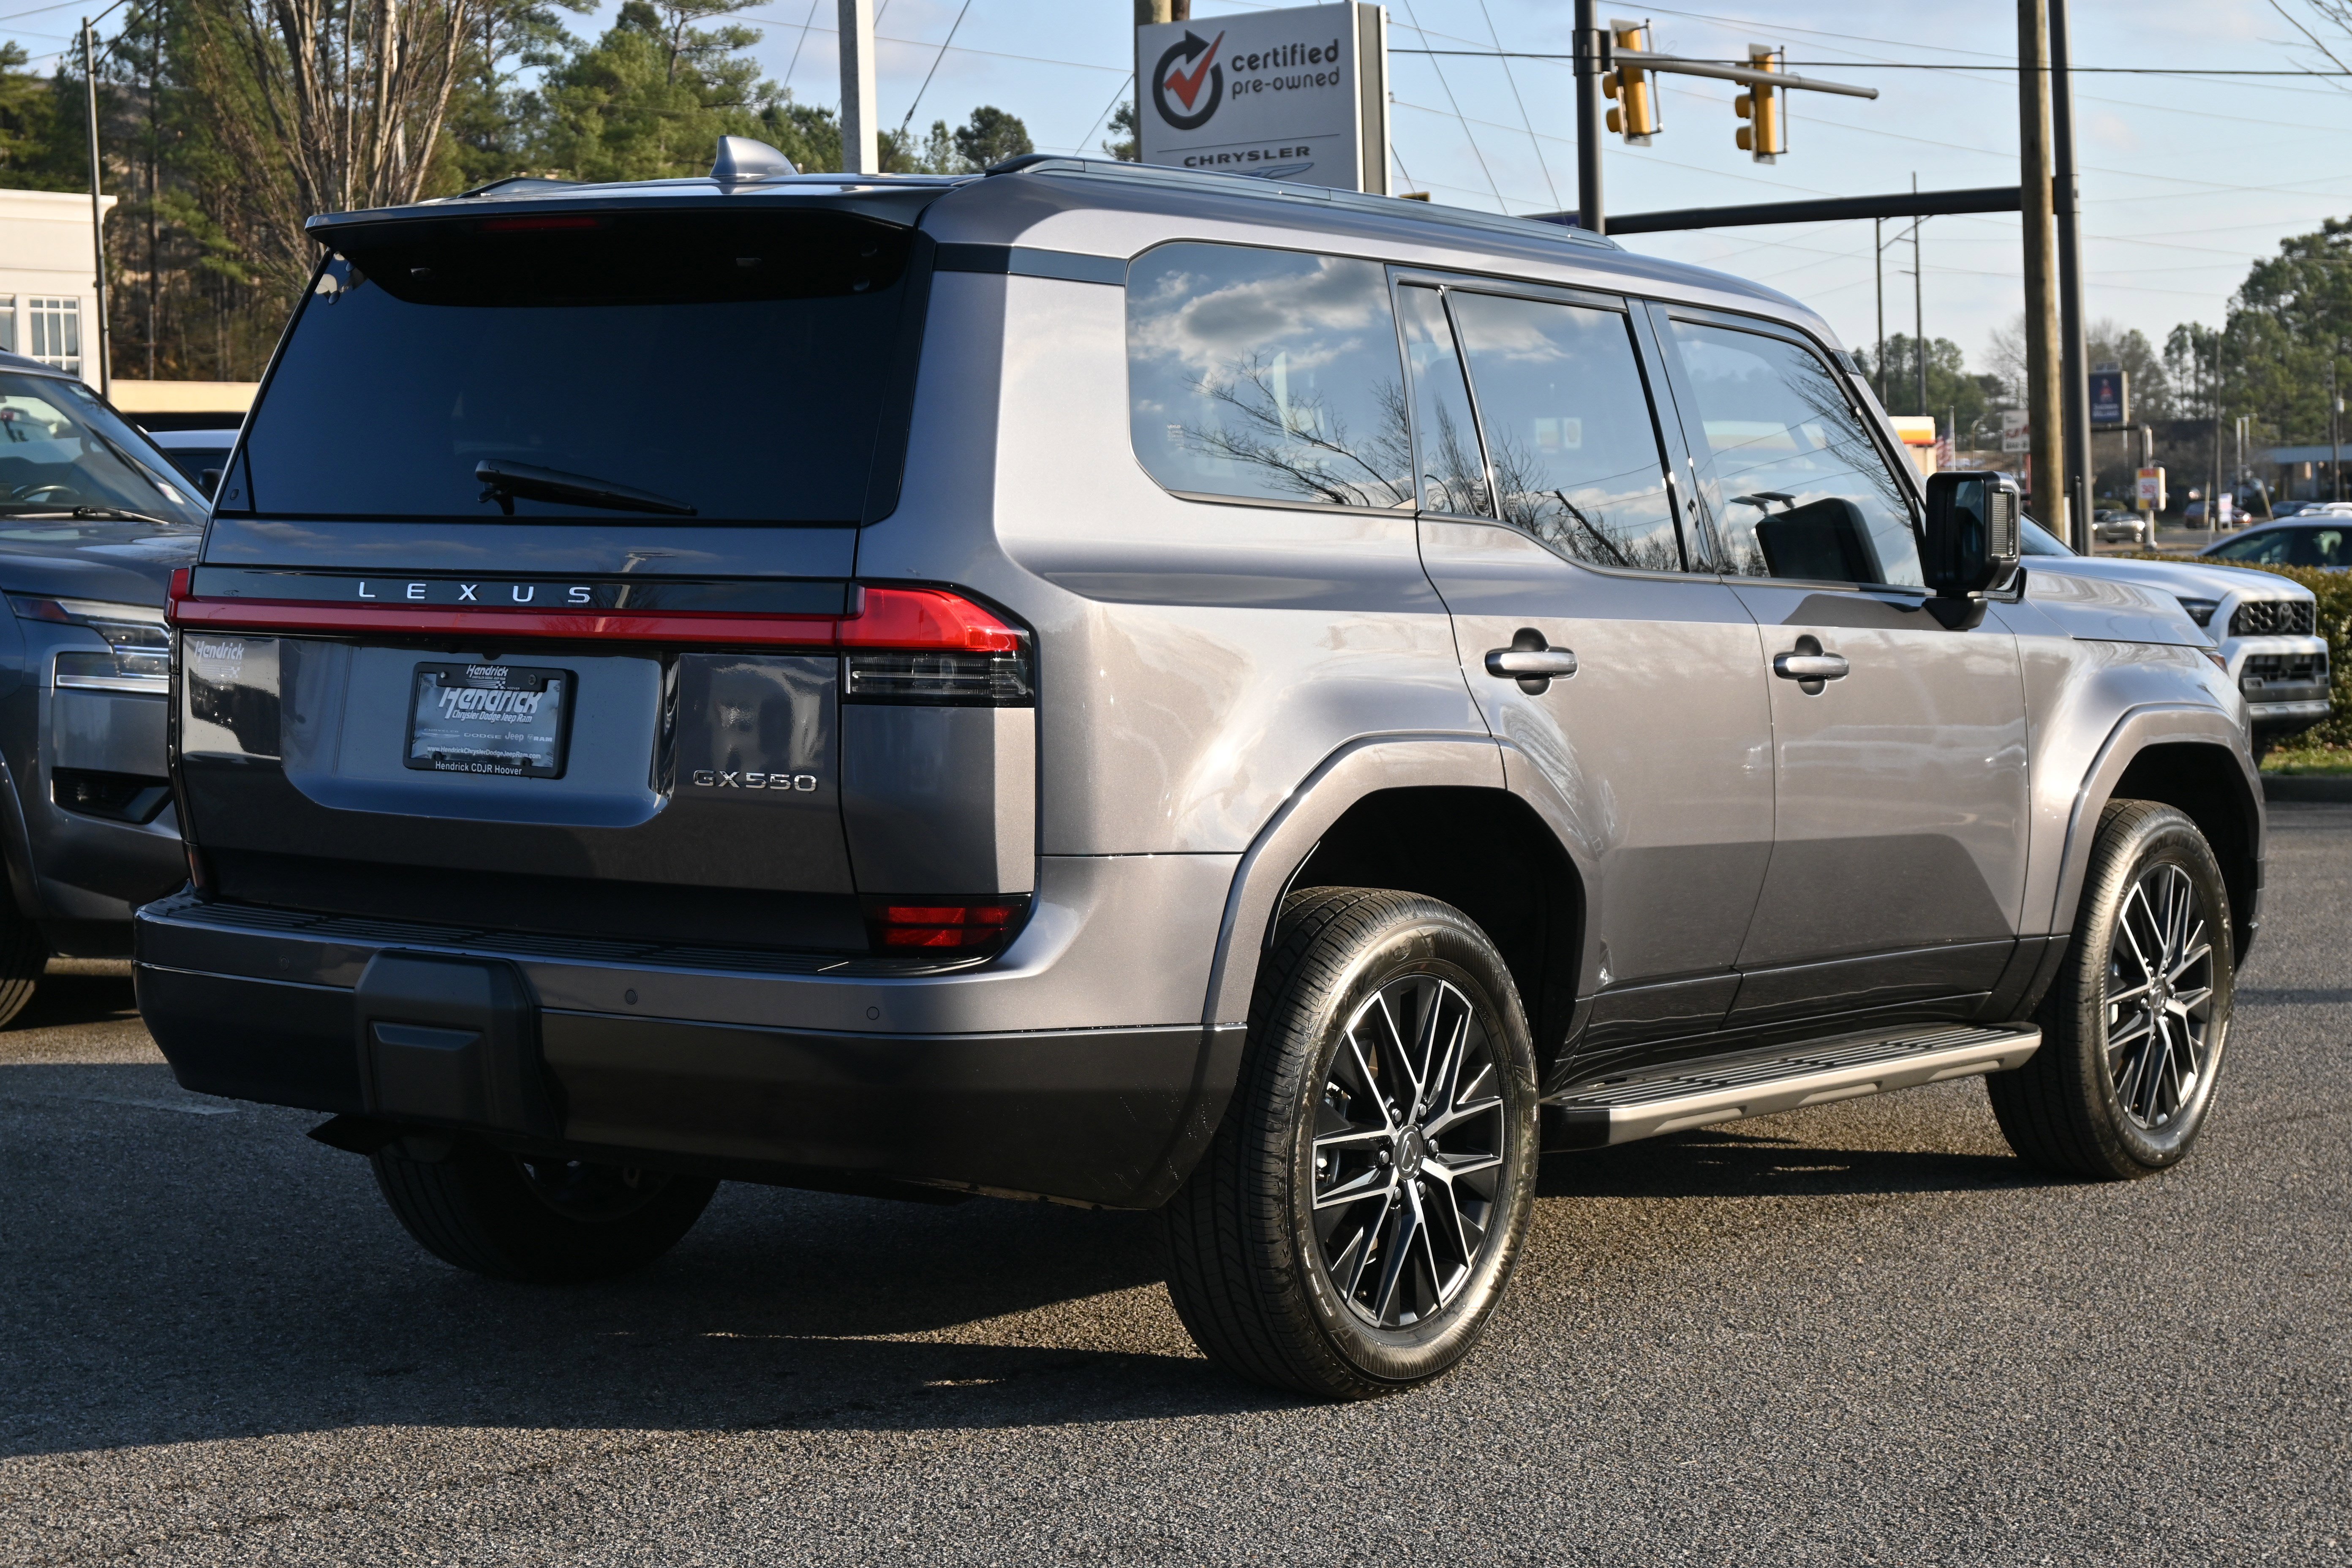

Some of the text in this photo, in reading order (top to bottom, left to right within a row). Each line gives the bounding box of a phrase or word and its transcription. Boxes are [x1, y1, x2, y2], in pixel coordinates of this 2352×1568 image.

[1231, 38, 1339, 72] certified
[1232, 67, 1340, 100] pre-owned
[1184, 146, 1311, 168] CHRYSLER
[359, 581, 591, 603] LEXUS
[194, 640, 245, 663] Hendrick
[466, 664, 509, 678] Hendrick
[438, 687, 543, 719] Hendrick
[452, 709, 533, 723] Chrysler Dodge Jeep Ram
[505, 731, 524, 742] Jeep
[427, 746, 541, 760] www.HendrickChryslerDodgeJeepRam.com
[435, 761, 522, 775] Hendrick CDJR Hoover
